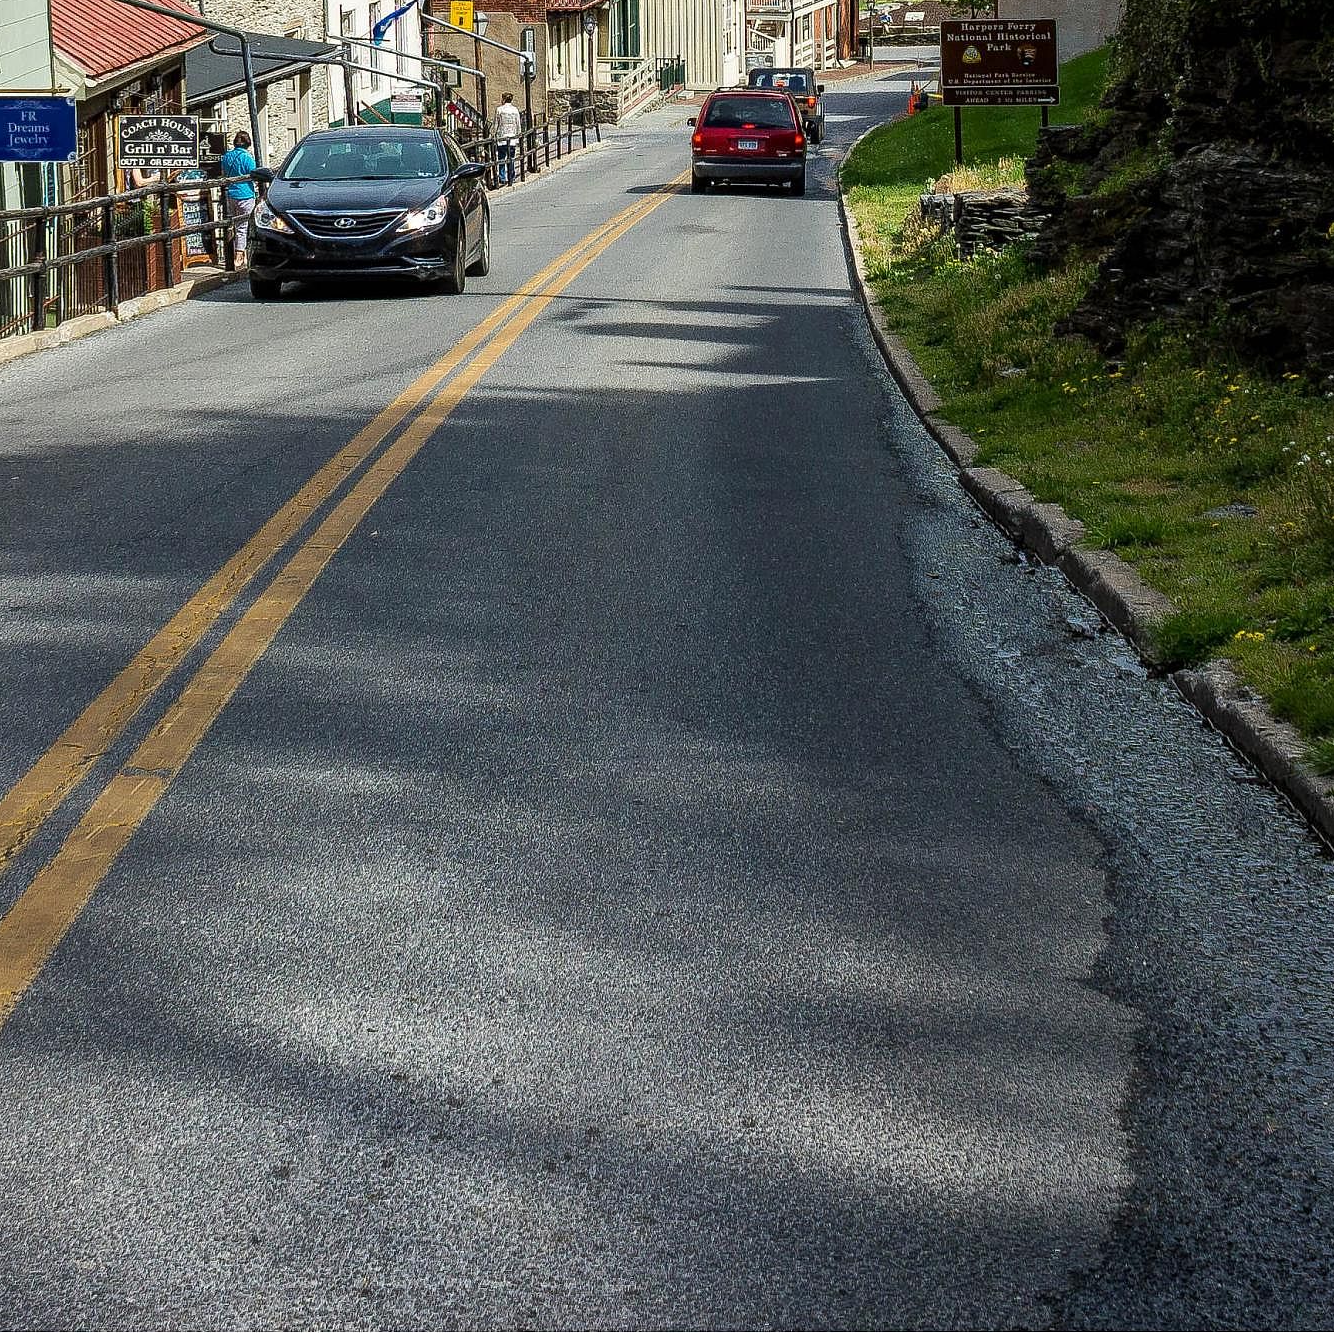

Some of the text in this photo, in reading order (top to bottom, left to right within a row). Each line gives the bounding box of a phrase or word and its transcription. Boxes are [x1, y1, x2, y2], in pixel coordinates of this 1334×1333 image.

[961, 22, 1036, 32] Harpers Ferry
[947, 32, 1052, 41] National Historical
[987, 43, 1012, 52] Park
[21, 111, 37, 122] FR
[8, 122, 50, 133] Dreams
[121, 118, 196, 140] COACH HOUSE
[7, 133, 49, 146] Jewelry
[124, 144, 193, 154] Grill n' Bar
[163, 158, 197, 166] SEATING
